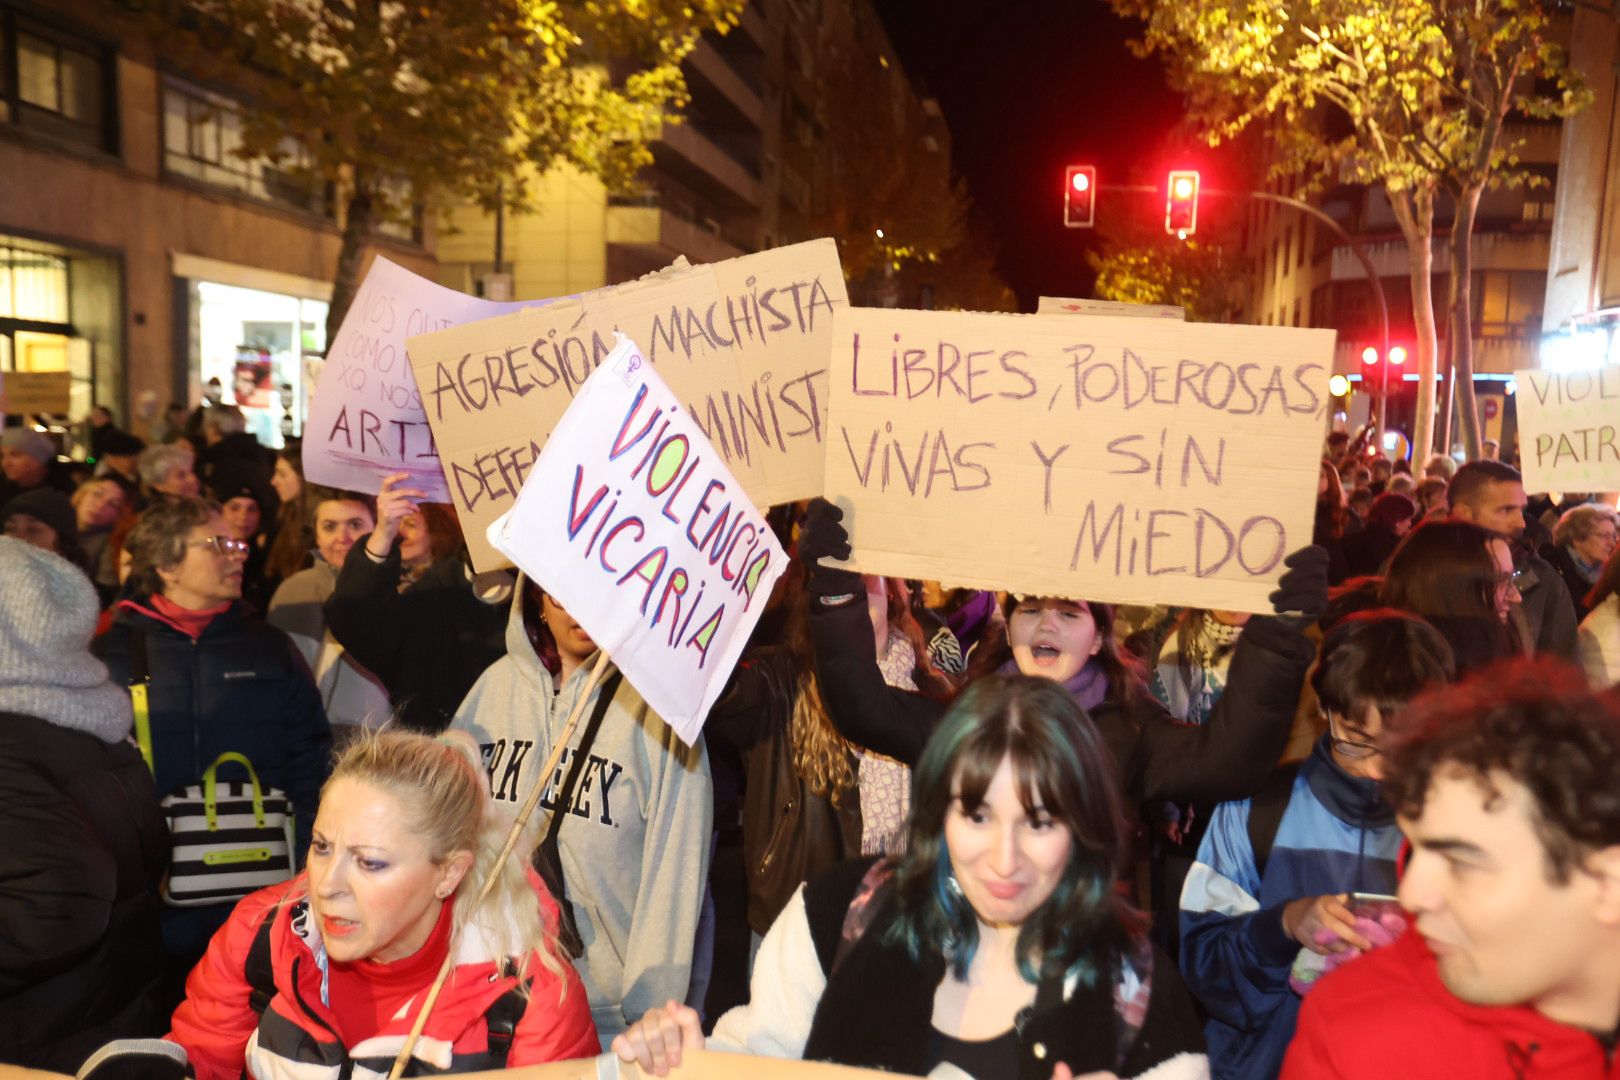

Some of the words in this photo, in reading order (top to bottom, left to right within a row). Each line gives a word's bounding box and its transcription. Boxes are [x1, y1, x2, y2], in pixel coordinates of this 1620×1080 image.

[650, 274, 842, 363] MACHISTA
[1030, 440, 1071, 514] Y
[1536, 424, 1620, 468] PATR
[1069, 500, 1287, 578] MIEDO
